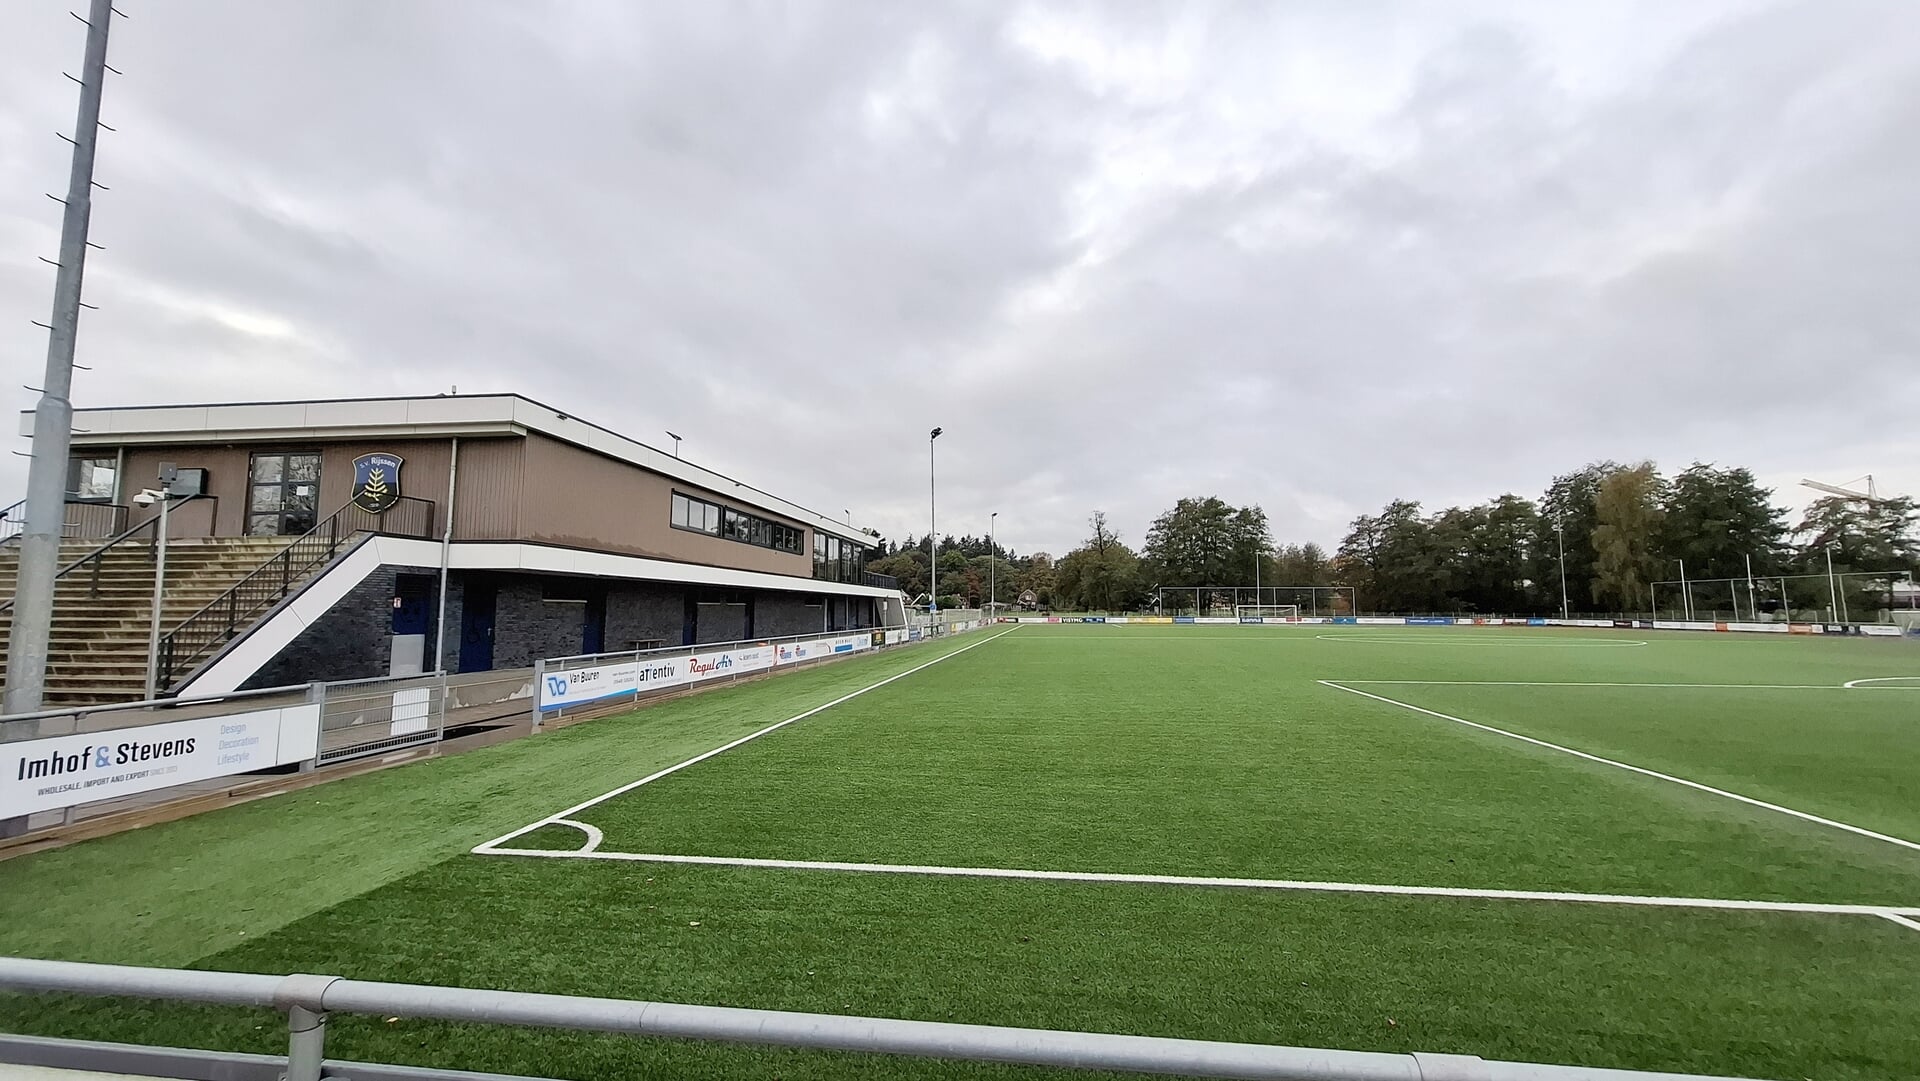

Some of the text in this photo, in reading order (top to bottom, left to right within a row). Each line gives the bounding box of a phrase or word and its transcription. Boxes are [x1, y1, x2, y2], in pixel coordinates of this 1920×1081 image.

[371, 457, 396, 468] Rijssen
[569, 672, 580, 684] Van
[581, 671, 600, 684] Buuren
[220, 724, 247, 736] Design
[218, 736, 260, 750] Decoration
[18, 738, 196, 781] Imhof & Stevens
[217, 751, 250, 765] Lifestyle
[83, 777, 110, 789] IMPORT
[110, 774, 125, 784] AND
[125, 769, 150, 781] EXPORT
